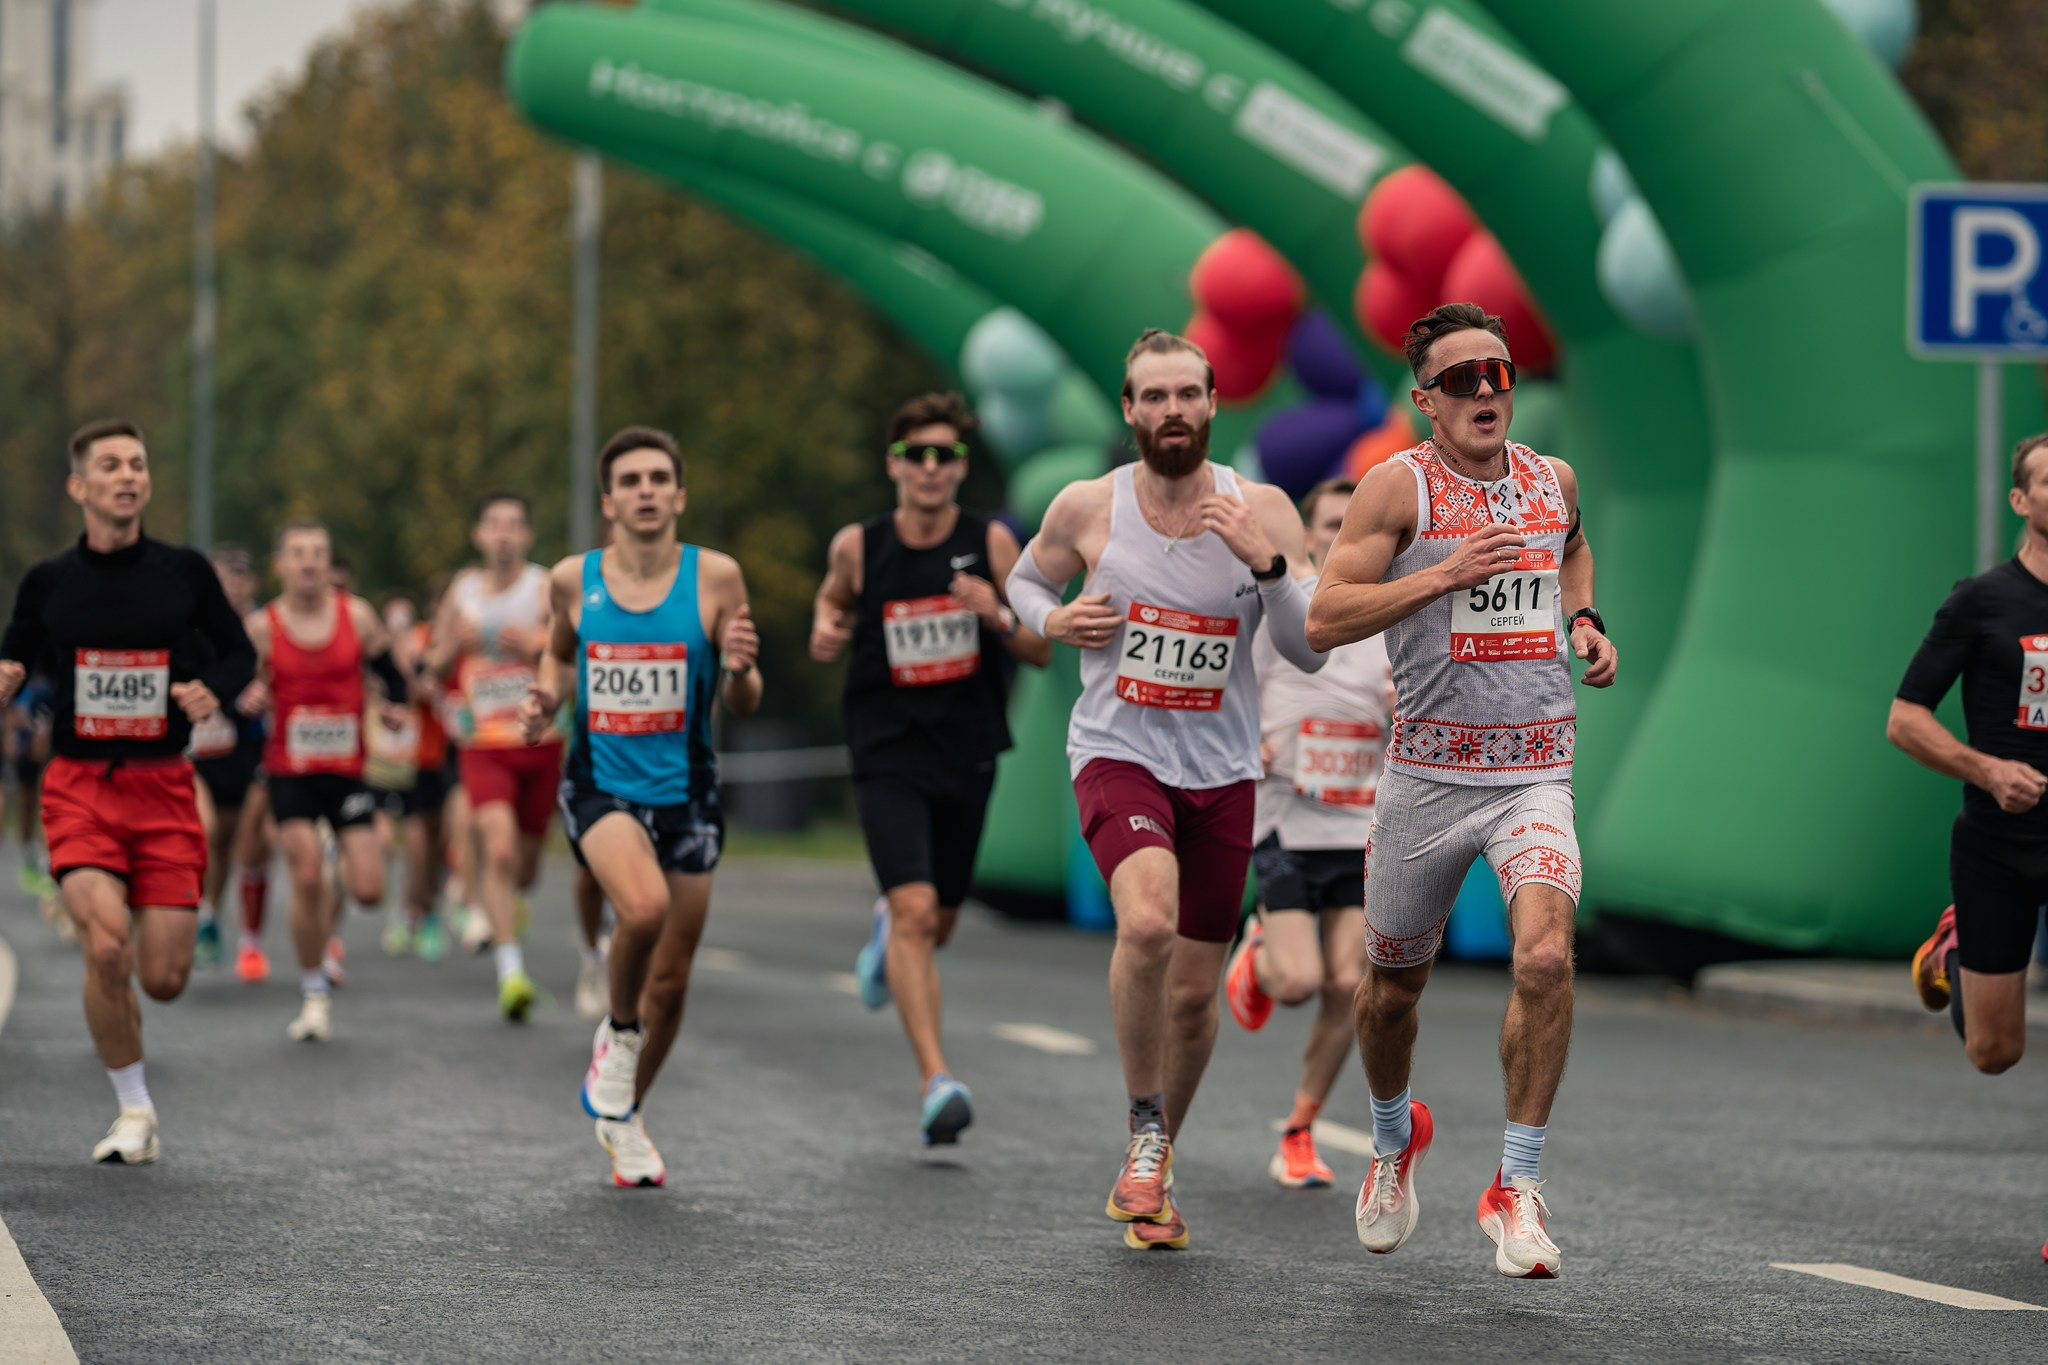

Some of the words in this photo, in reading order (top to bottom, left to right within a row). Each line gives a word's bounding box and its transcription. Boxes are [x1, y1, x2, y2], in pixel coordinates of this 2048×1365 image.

[1952, 206, 2041, 338] P
[1469, 577, 1541, 612] 5611
[1490, 614, 1525, 627] СЕРГЕЙ
[1126, 630, 1229, 671] 21163
[87, 673, 156, 701] 3485
[592, 667, 680, 695] 20611
[1154, 668, 1194, 683] СЕРГЕЙ
[2027, 666, 2048, 693] 3
